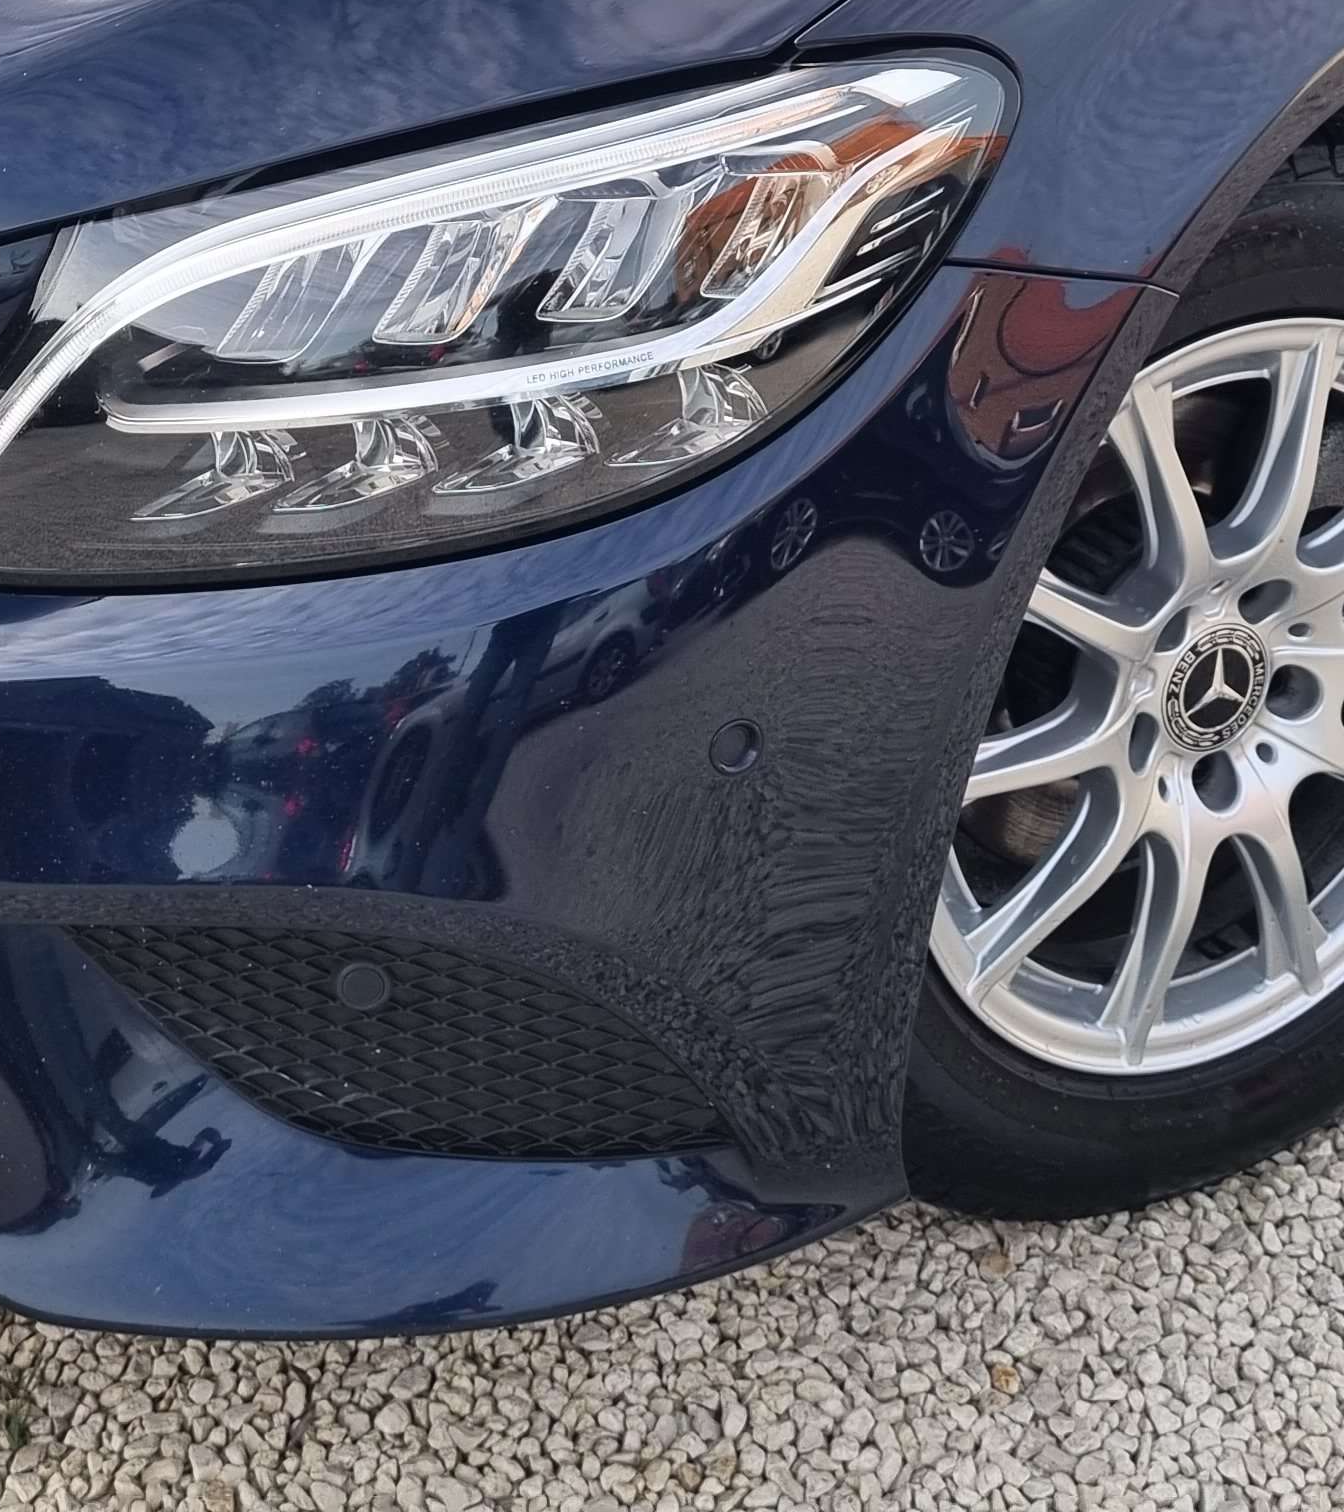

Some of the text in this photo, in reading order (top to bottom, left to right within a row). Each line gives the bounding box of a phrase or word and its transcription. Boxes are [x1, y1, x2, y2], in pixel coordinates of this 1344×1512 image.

[526, 351, 655, 385] LED HIGH PERFORMANCE
[1169, 651, 1196, 694] BENZ
[1222, 661, 1265, 738] MERCEDES
